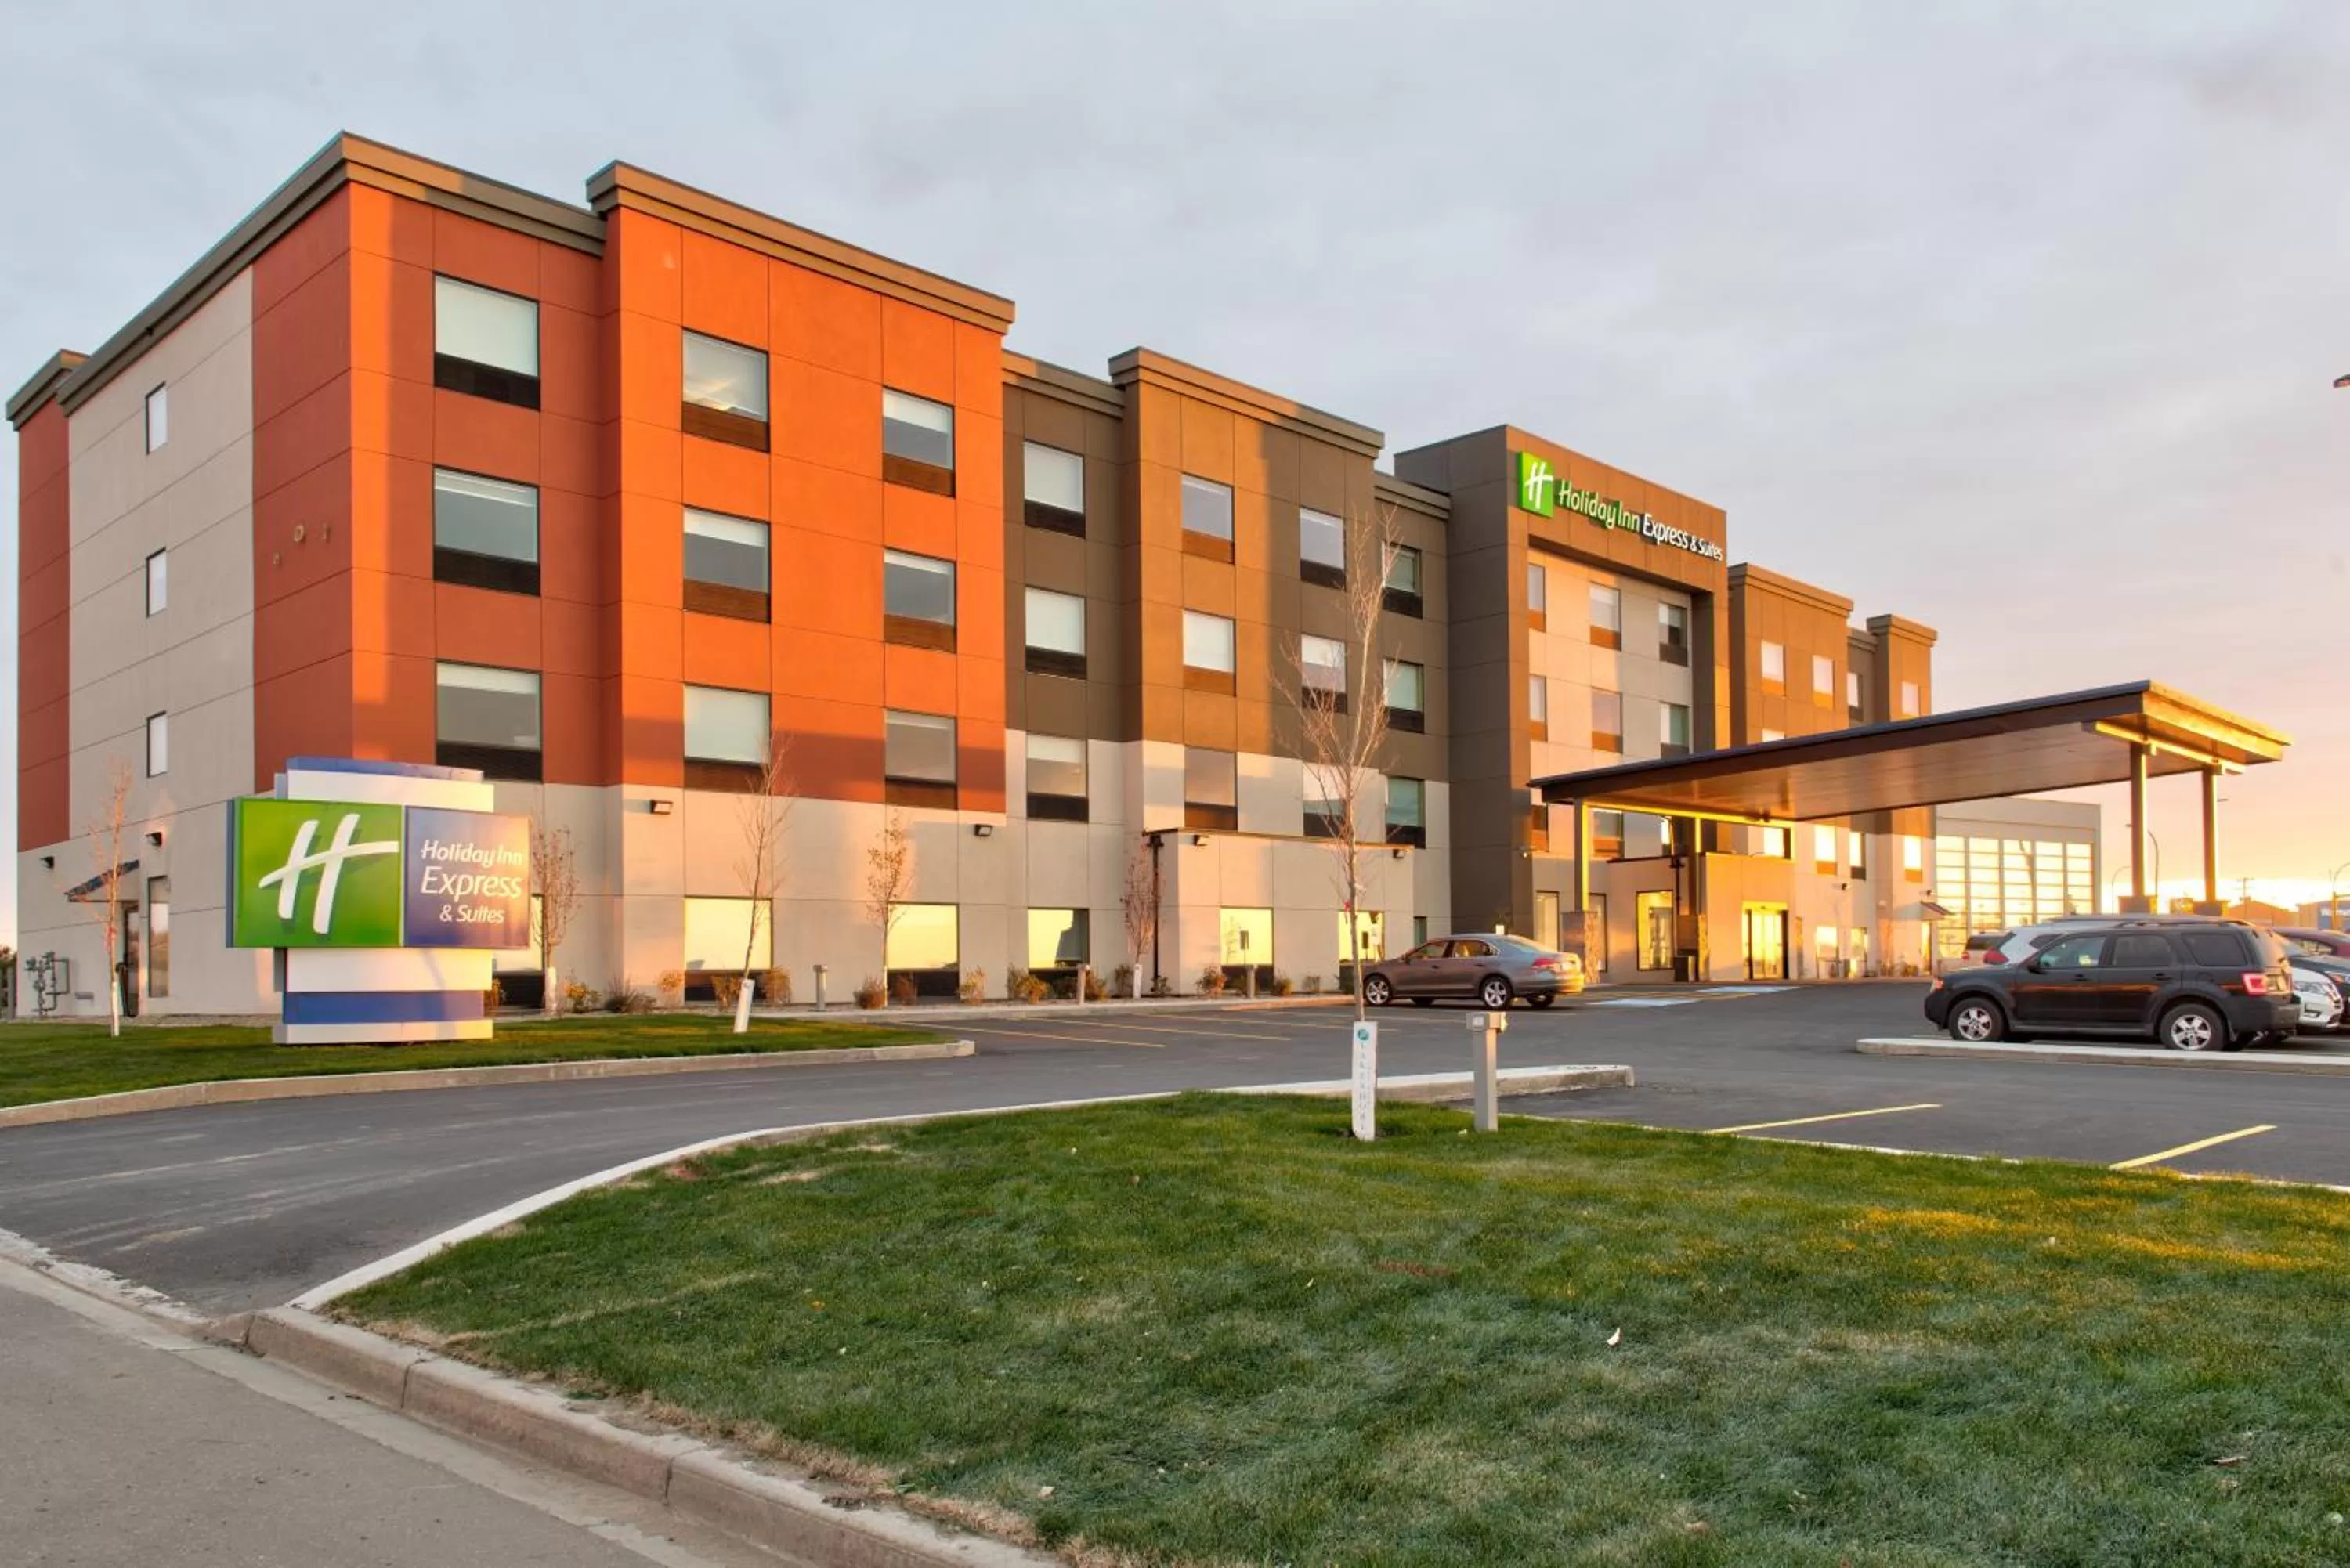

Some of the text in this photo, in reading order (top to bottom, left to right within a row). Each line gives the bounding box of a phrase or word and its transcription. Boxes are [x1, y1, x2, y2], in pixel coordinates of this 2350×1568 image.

[1559, 479, 1723, 561] Holiday Inn Express & Suites
[421, 840, 522, 869] Holiday Inn
[421, 865, 523, 902] Express
[439, 904, 505, 923] & Suites
